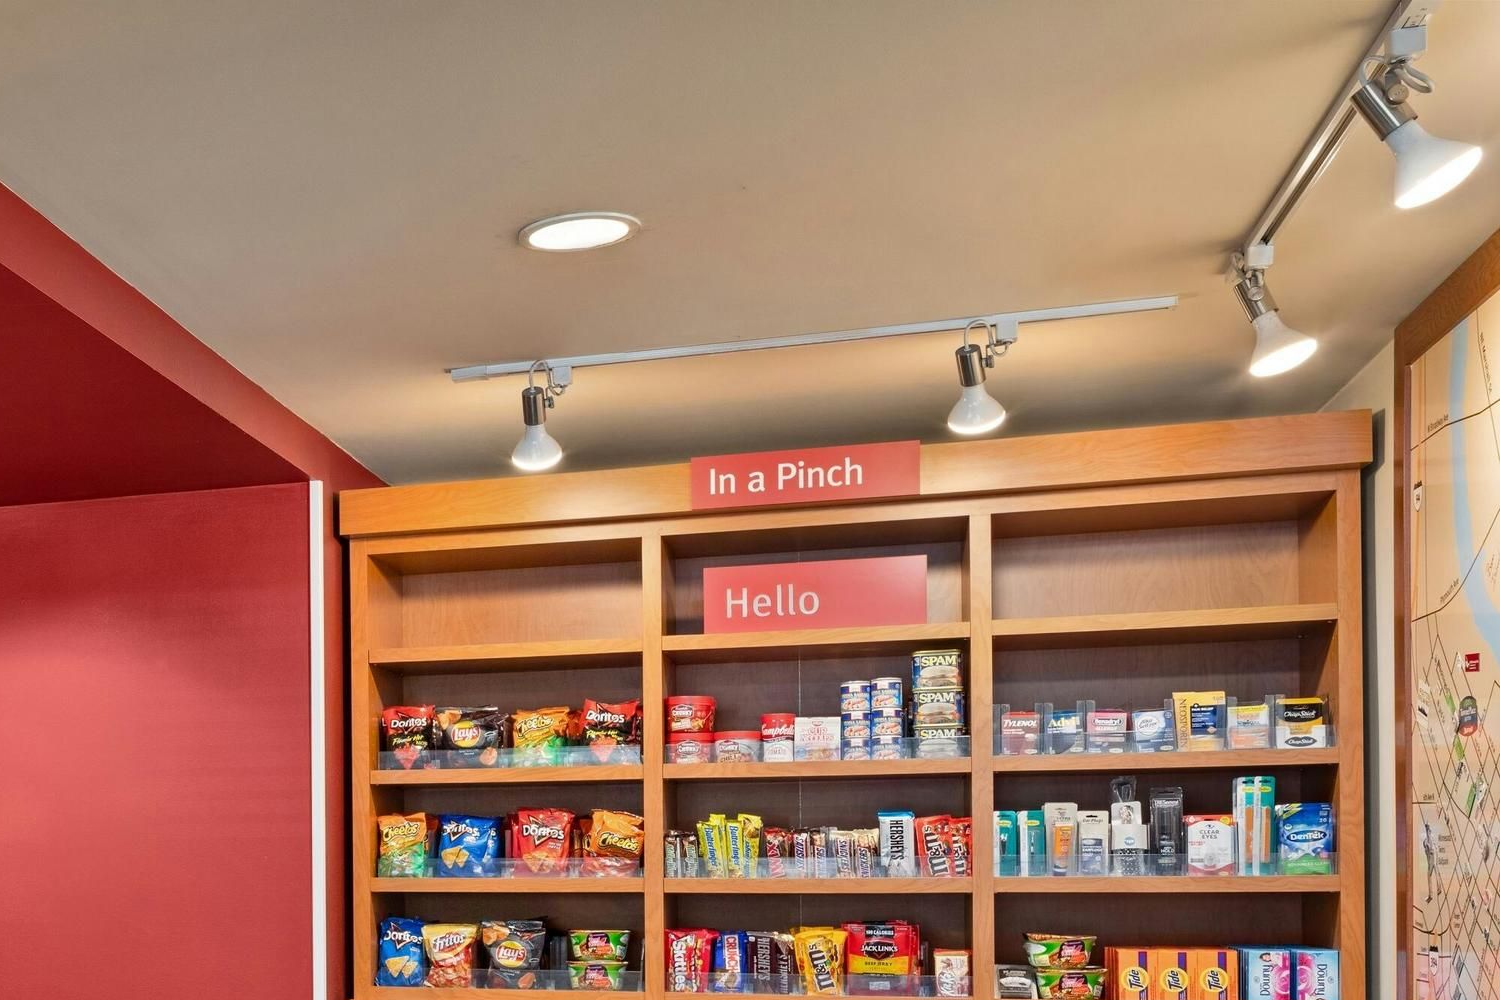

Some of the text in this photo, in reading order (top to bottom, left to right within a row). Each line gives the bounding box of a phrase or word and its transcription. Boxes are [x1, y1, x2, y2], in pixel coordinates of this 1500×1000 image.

[708, 456, 864, 496] In a Pinch
[725, 582, 821, 619] Hello
[921, 654, 957, 667] SPAM
[919, 692, 955, 704] SPAM
[390, 716, 428, 729] Doritos
[516, 713, 555, 738] Cheetos
[585, 709, 626, 724] Doritos
[1002, 718, 1038, 728] TYLENOL
[1048, 716, 1081, 728] Advil
[1178, 697, 1189, 750] NEOSPORIN
[920, 728, 956, 740] SPAM
[382, 820, 420, 842] Cheetos
[522, 823, 565, 840] Doritos
[598, 830, 640, 852] Cheetos
[1290, 831, 1325, 841] DenTek
[703, 826, 717, 868] Butterfinger
[729, 824, 740, 866] Butterfinger
[432, 931, 467, 952] Fritos
[725, 935, 739, 973] CRUNCH
[672, 940, 687, 992] Skittles
[1128, 969, 1144, 990] Tide
[1168, 969, 1183, 990] Tide
[1207, 970, 1222, 991] Tide
[1259, 963, 1275, 997] Downy
[1313, 963, 1328, 997] Downy
